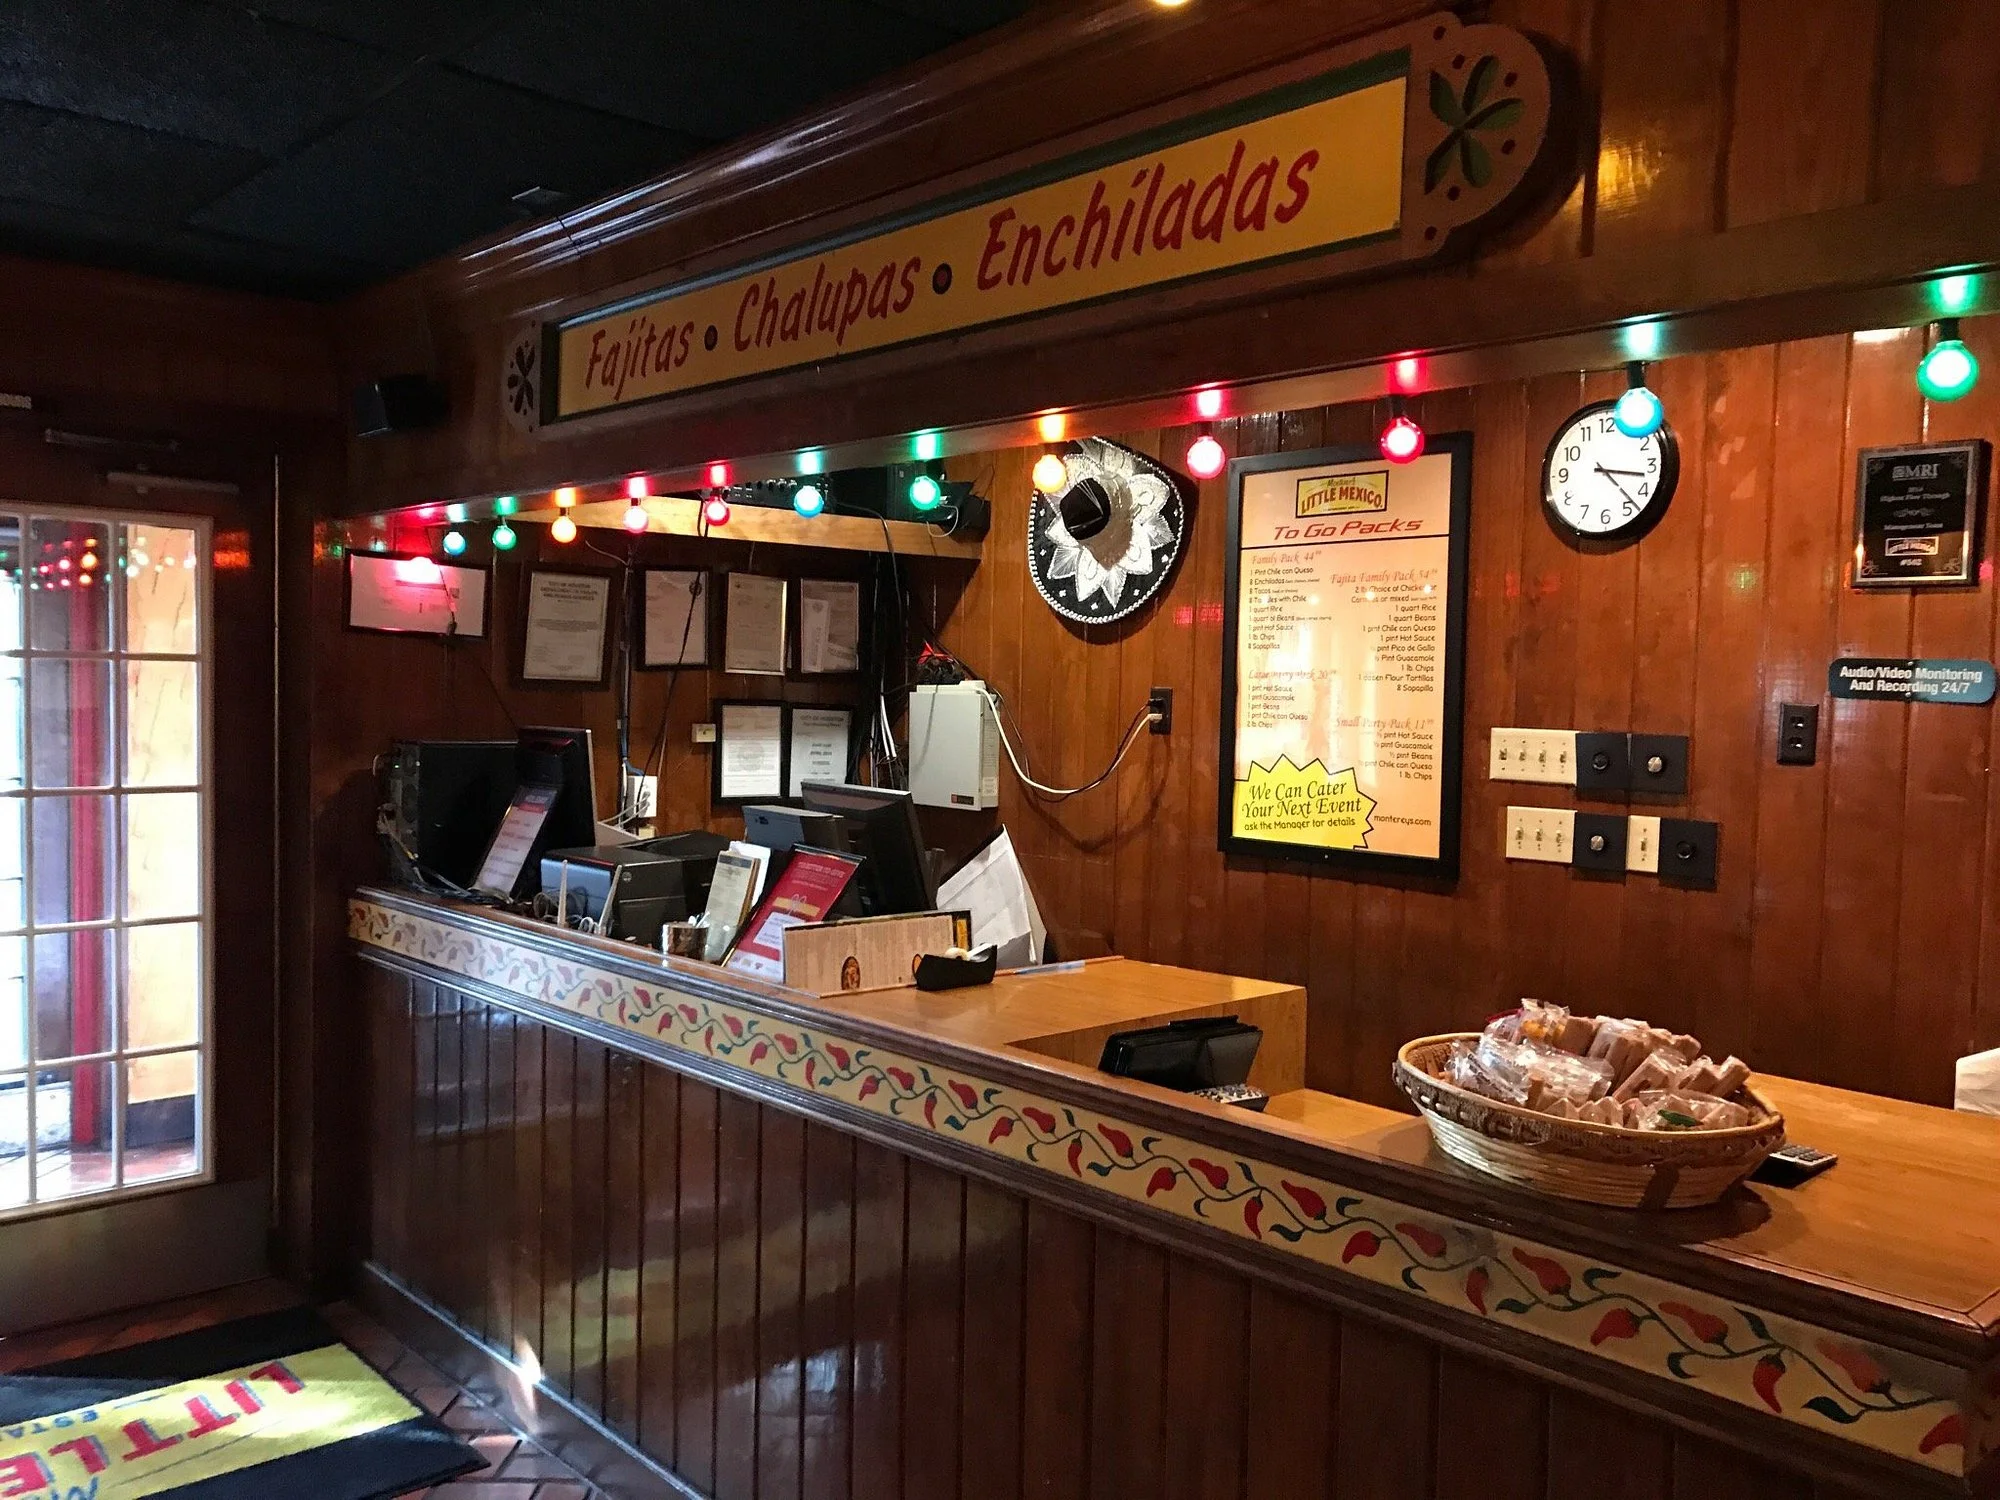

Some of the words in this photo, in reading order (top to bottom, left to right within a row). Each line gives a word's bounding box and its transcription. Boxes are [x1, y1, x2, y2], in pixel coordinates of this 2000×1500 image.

[584, 315, 696, 401] Fajitas
[733, 249, 921, 352] Chalupas
[977, 138, 1320, 291] Enchiladas
[1599, 417, 1615, 433] 12
[1581, 427, 1591, 442] 11
[1640, 437, 1649, 451] 2
[1564, 446, 1580, 462] 10
[1647, 458, 1657, 473] 3
[1559, 468, 1568, 483] 9
[1638, 482, 1648, 497] 4
[1301, 487, 1337, 514] LITTLE
[1581, 505, 1589, 519] 7
[1622, 501, 1633, 516] 5
[1601, 509, 1611, 524] 6
[1274, 526, 1300, 540] To
[1304, 523, 1336, 538] Go
[1340, 518, 1423, 536] Packs
[1401, 604, 1420, 613] quart
[1422, 603, 1437, 611] Rice
[1393, 614, 1413, 623] quart
[1381, 624, 1398, 632] Chile
[1413, 624, 1436, 632] Queso
[1386, 634, 1398, 643] pint
[1400, 634, 1412, 642] Hot
[1413, 634, 1435, 642] Sauce
[1377, 644, 1390, 653] pint
[1391, 644, 1405, 652] Pico
[1407, 644, 1415, 652] de
[1417, 644, 1435, 652] Gallo
[1381, 654, 1395, 662] Pint
[1396, 654, 1434, 662] Guacamole
[1415, 664, 1434, 673] Chips
[1839, 665, 1912, 679] Audio/Video
[1915, 668, 1983, 682] Monitoring
[1406, 674, 1434, 682] Tortillas
[1850, 679, 1874, 691] And
[1877, 680, 1938, 695] Recording
[1942, 682, 1970, 694] 24/7
[1384, 731, 1396, 739] pint
[1412, 732, 1433, 740] Sauce
[1381, 741, 1393, 749] pint
[1394, 741, 1433, 750] Guacamole
[1396, 751, 1409, 759] pint
[1411, 752, 1433, 760] Beans
[1379, 760, 1395, 768] Chile
[1396, 761, 1409, 769] con
[1410, 761, 1433, 770] Queso
[1413, 771, 1433, 781] Chips
[1249, 782, 1271, 801] We
[1275, 783, 1302, 801] Can
[1306, 780, 1347, 799] Cater
[1241, 800, 1274, 819] Your
[1277, 799, 1312, 819] Next
[1316, 797, 1362, 815] Event
[1244, 821, 1258, 831] ask
[1260, 821, 1272, 830] the
[1274, 820, 1310, 830] Manager
[1312, 819, 1324, 828] for
[1327, 817, 1356, 827] details
[1374, 815, 1432, 826] montereys.com
[0, 1361, 305, 1498] LITTLE
